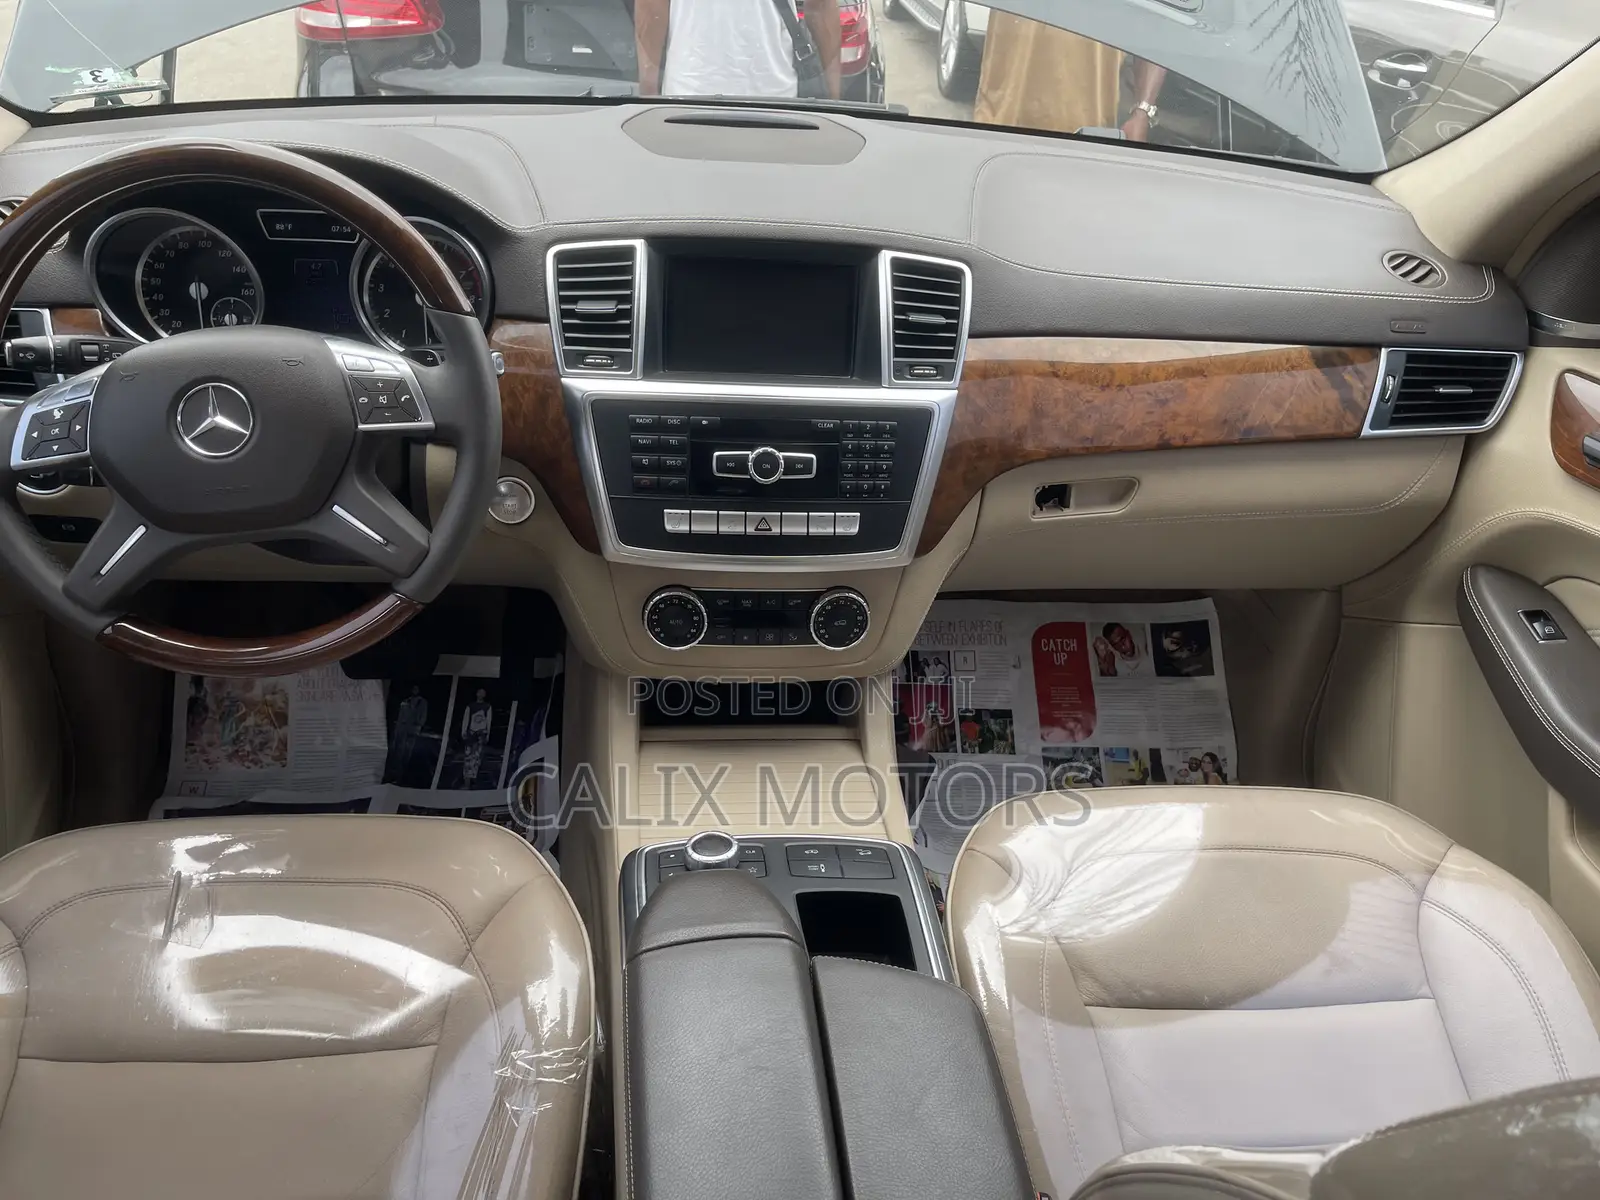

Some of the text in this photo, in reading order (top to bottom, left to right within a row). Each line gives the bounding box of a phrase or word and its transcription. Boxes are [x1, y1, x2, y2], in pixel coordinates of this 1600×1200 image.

[331, 225, 351, 233] 07:54
[178, 241, 189, 250] 80
[198, 240, 212, 248] 100
[164, 250, 175, 258] 70
[218, 250, 232, 258] 120
[232, 266, 247, 274] 140
[460, 270, 466, 280] 7
[150, 278, 162, 286] 50
[241, 288, 255, 296] 160
[378, 283, 384, 292] 3
[152, 293, 164, 301] 40
[159, 308, 170, 316] 30
[384, 309, 391, 318] 2
[172, 320, 182, 328] 20
[401, 329, 406, 338] 1
[50, 427, 60, 436] OK
[914, 633, 1008, 646] BETWEEN EXHIBITION
[1041, 638, 1078, 652] CATCH
[963, 656, 968, 665] R
[1053, 653, 1068, 666] UP
[189, 785, 199, 794] W
